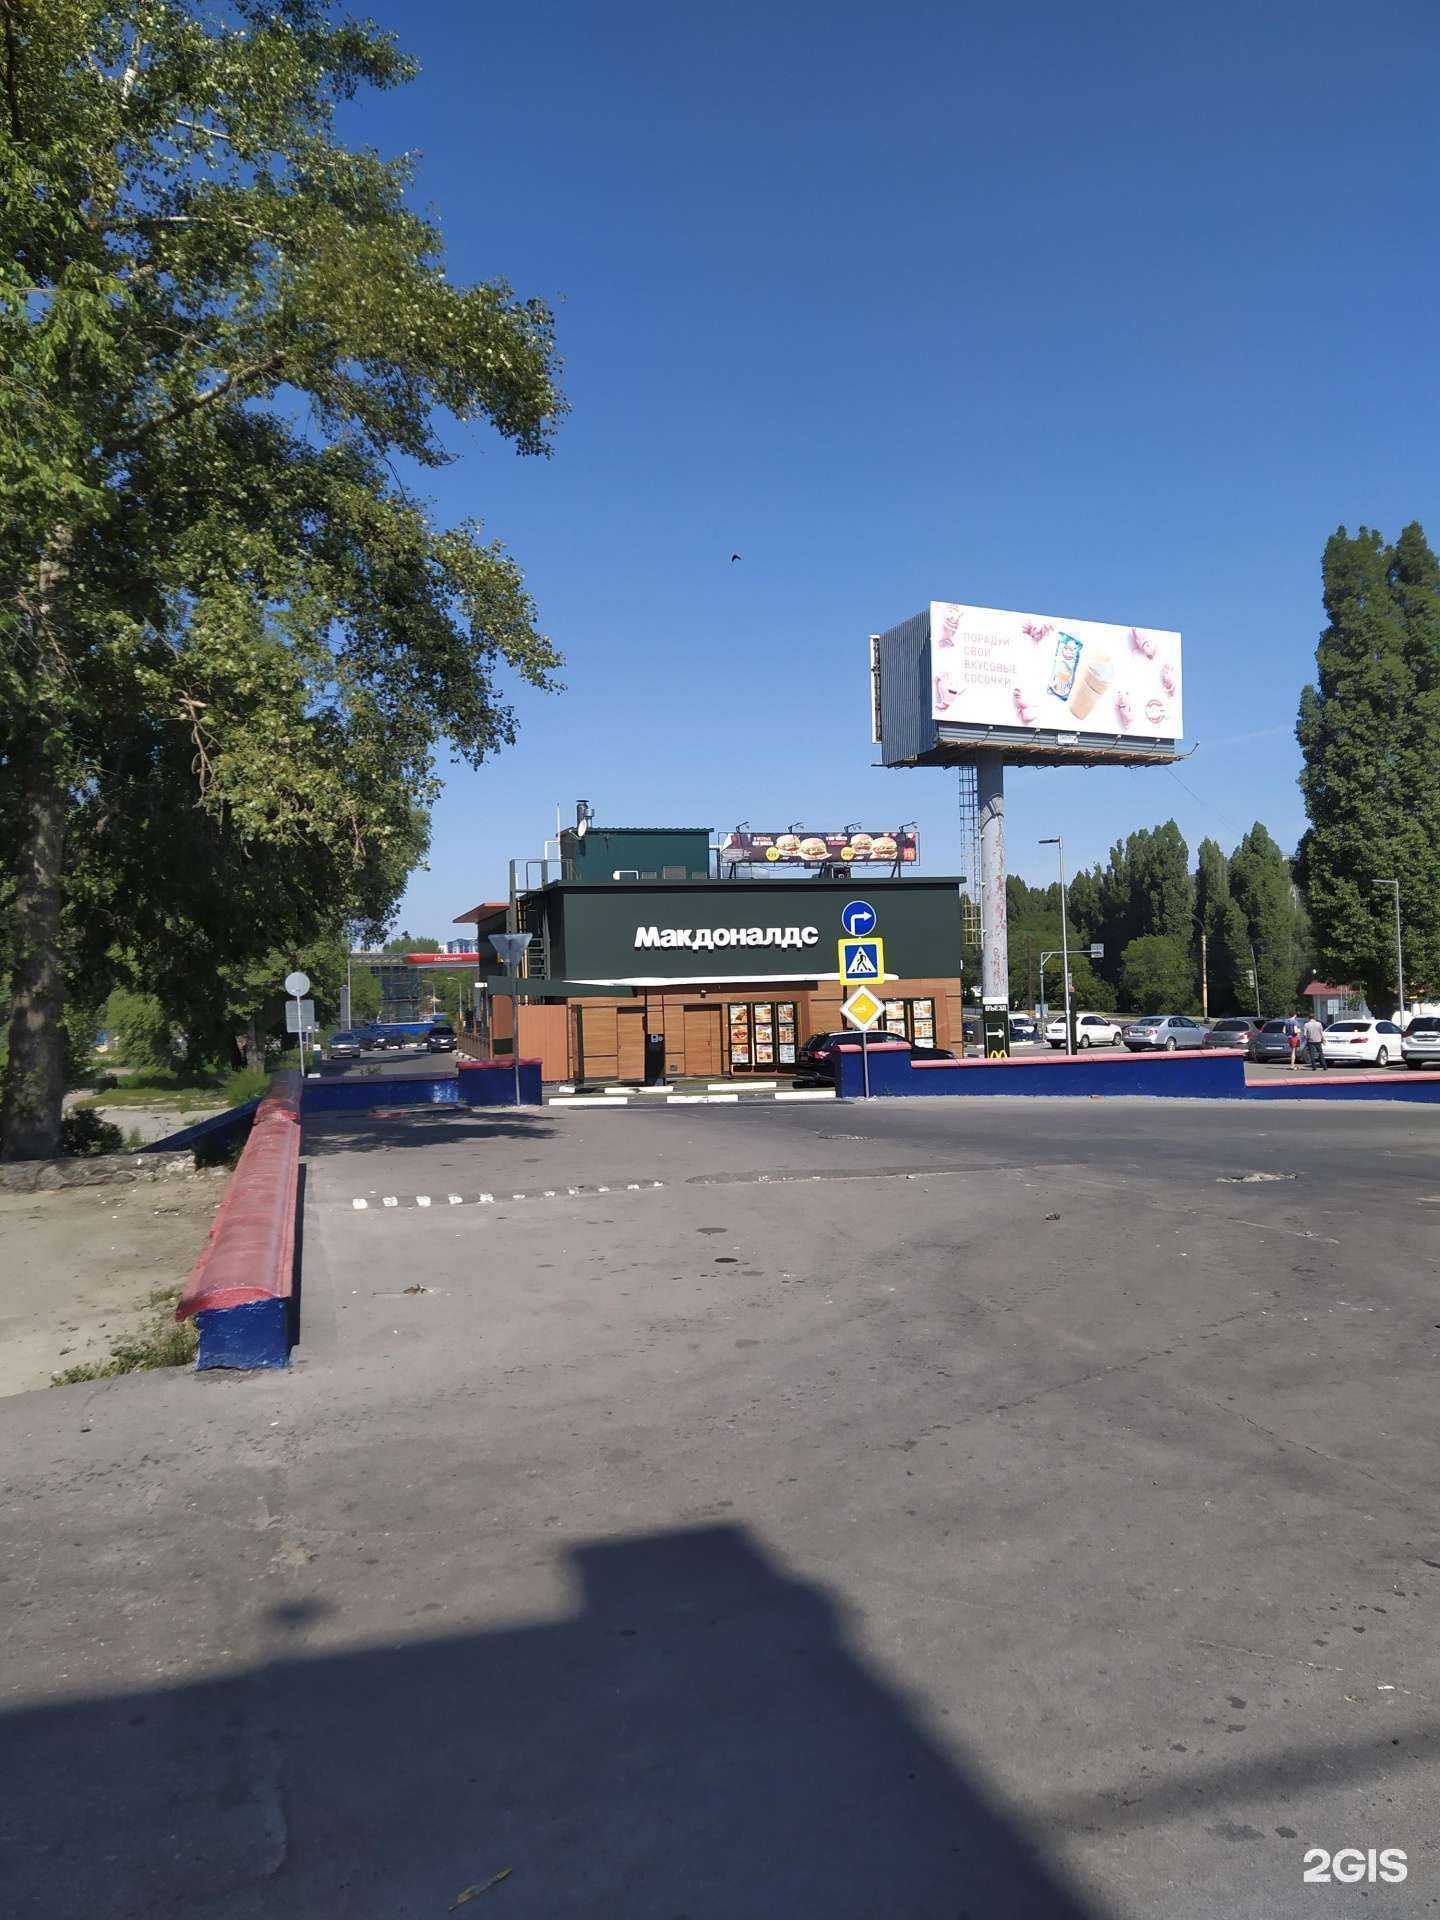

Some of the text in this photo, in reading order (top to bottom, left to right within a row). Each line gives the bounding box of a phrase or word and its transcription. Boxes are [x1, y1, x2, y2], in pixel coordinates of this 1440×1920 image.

[964, 660, 1016, 674] ВКУСОВЫЕ
[964, 673, 1011, 688] СОСОЧКИ
[634, 926, 819, 951] Макдоналдс
